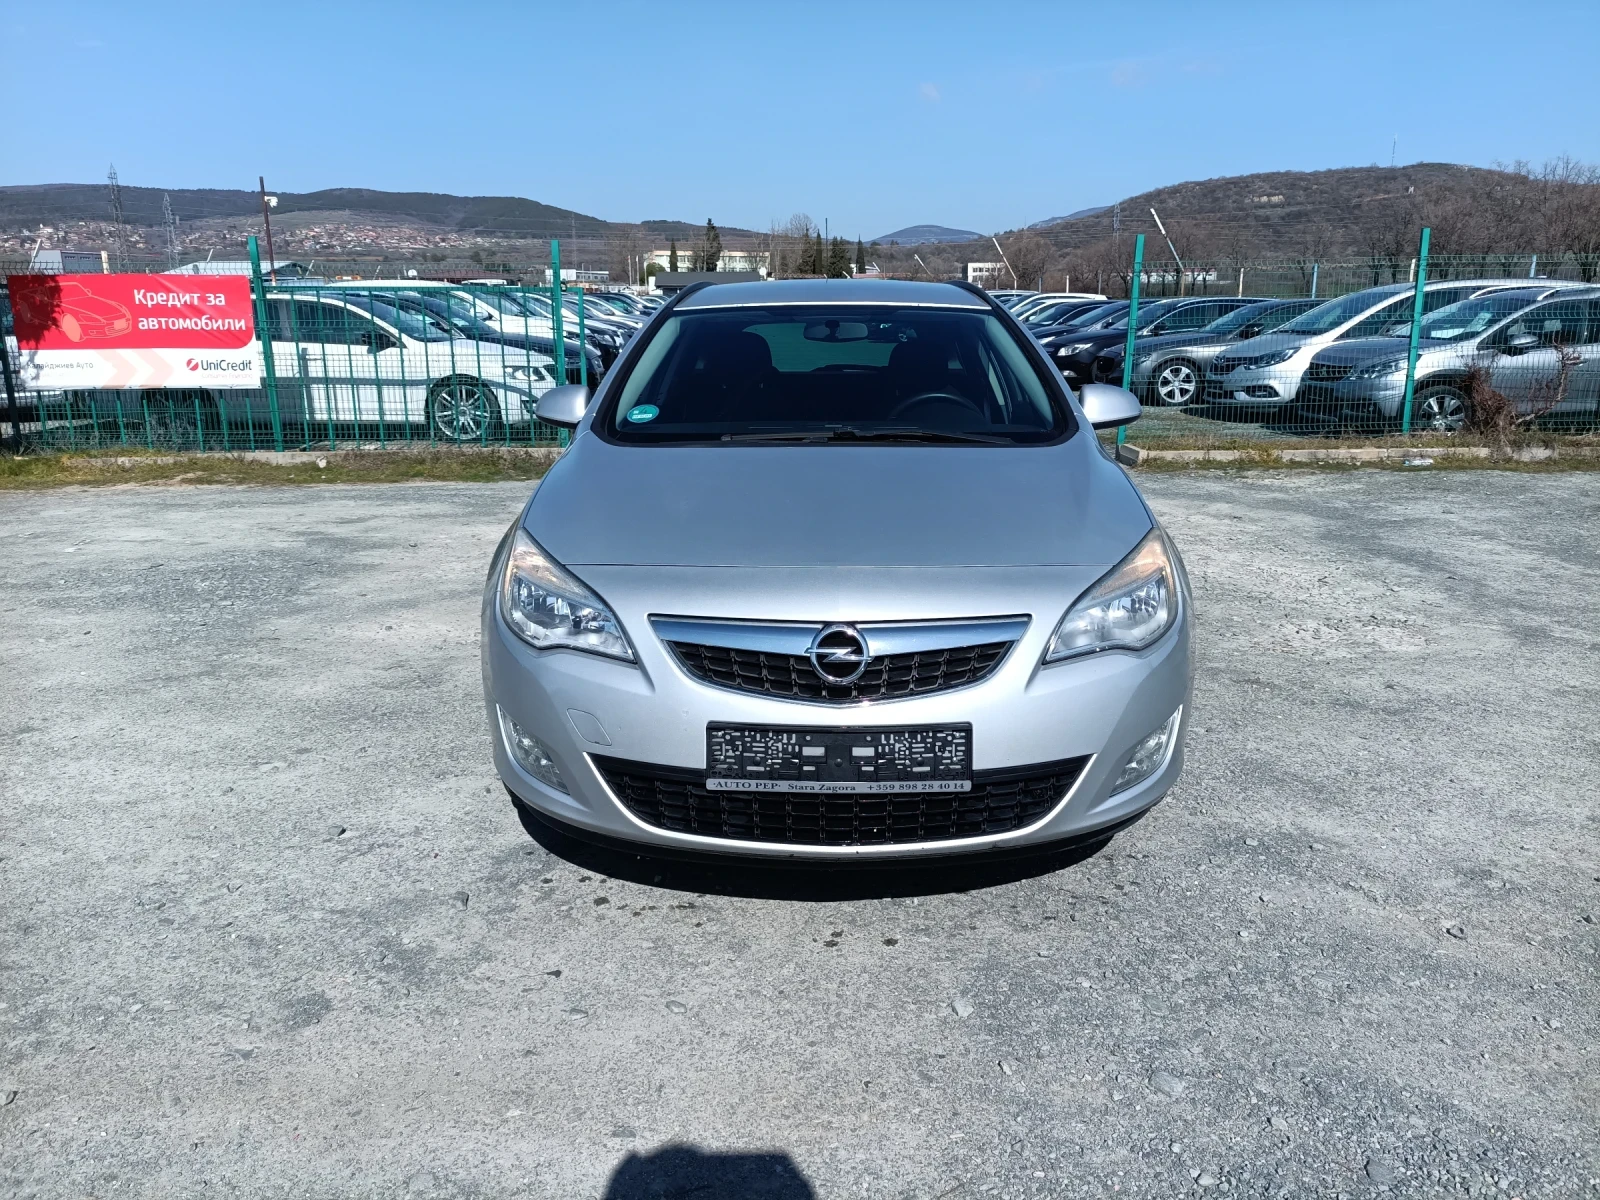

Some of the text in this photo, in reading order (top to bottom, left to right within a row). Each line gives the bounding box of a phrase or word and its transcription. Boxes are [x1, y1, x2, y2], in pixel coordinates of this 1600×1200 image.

[133, 289, 225, 308] Кредит за
[138, 314, 246, 330] автомобили
[200, 359, 252, 371] UniCredit
[818, 784, 856, 793] Zagora
